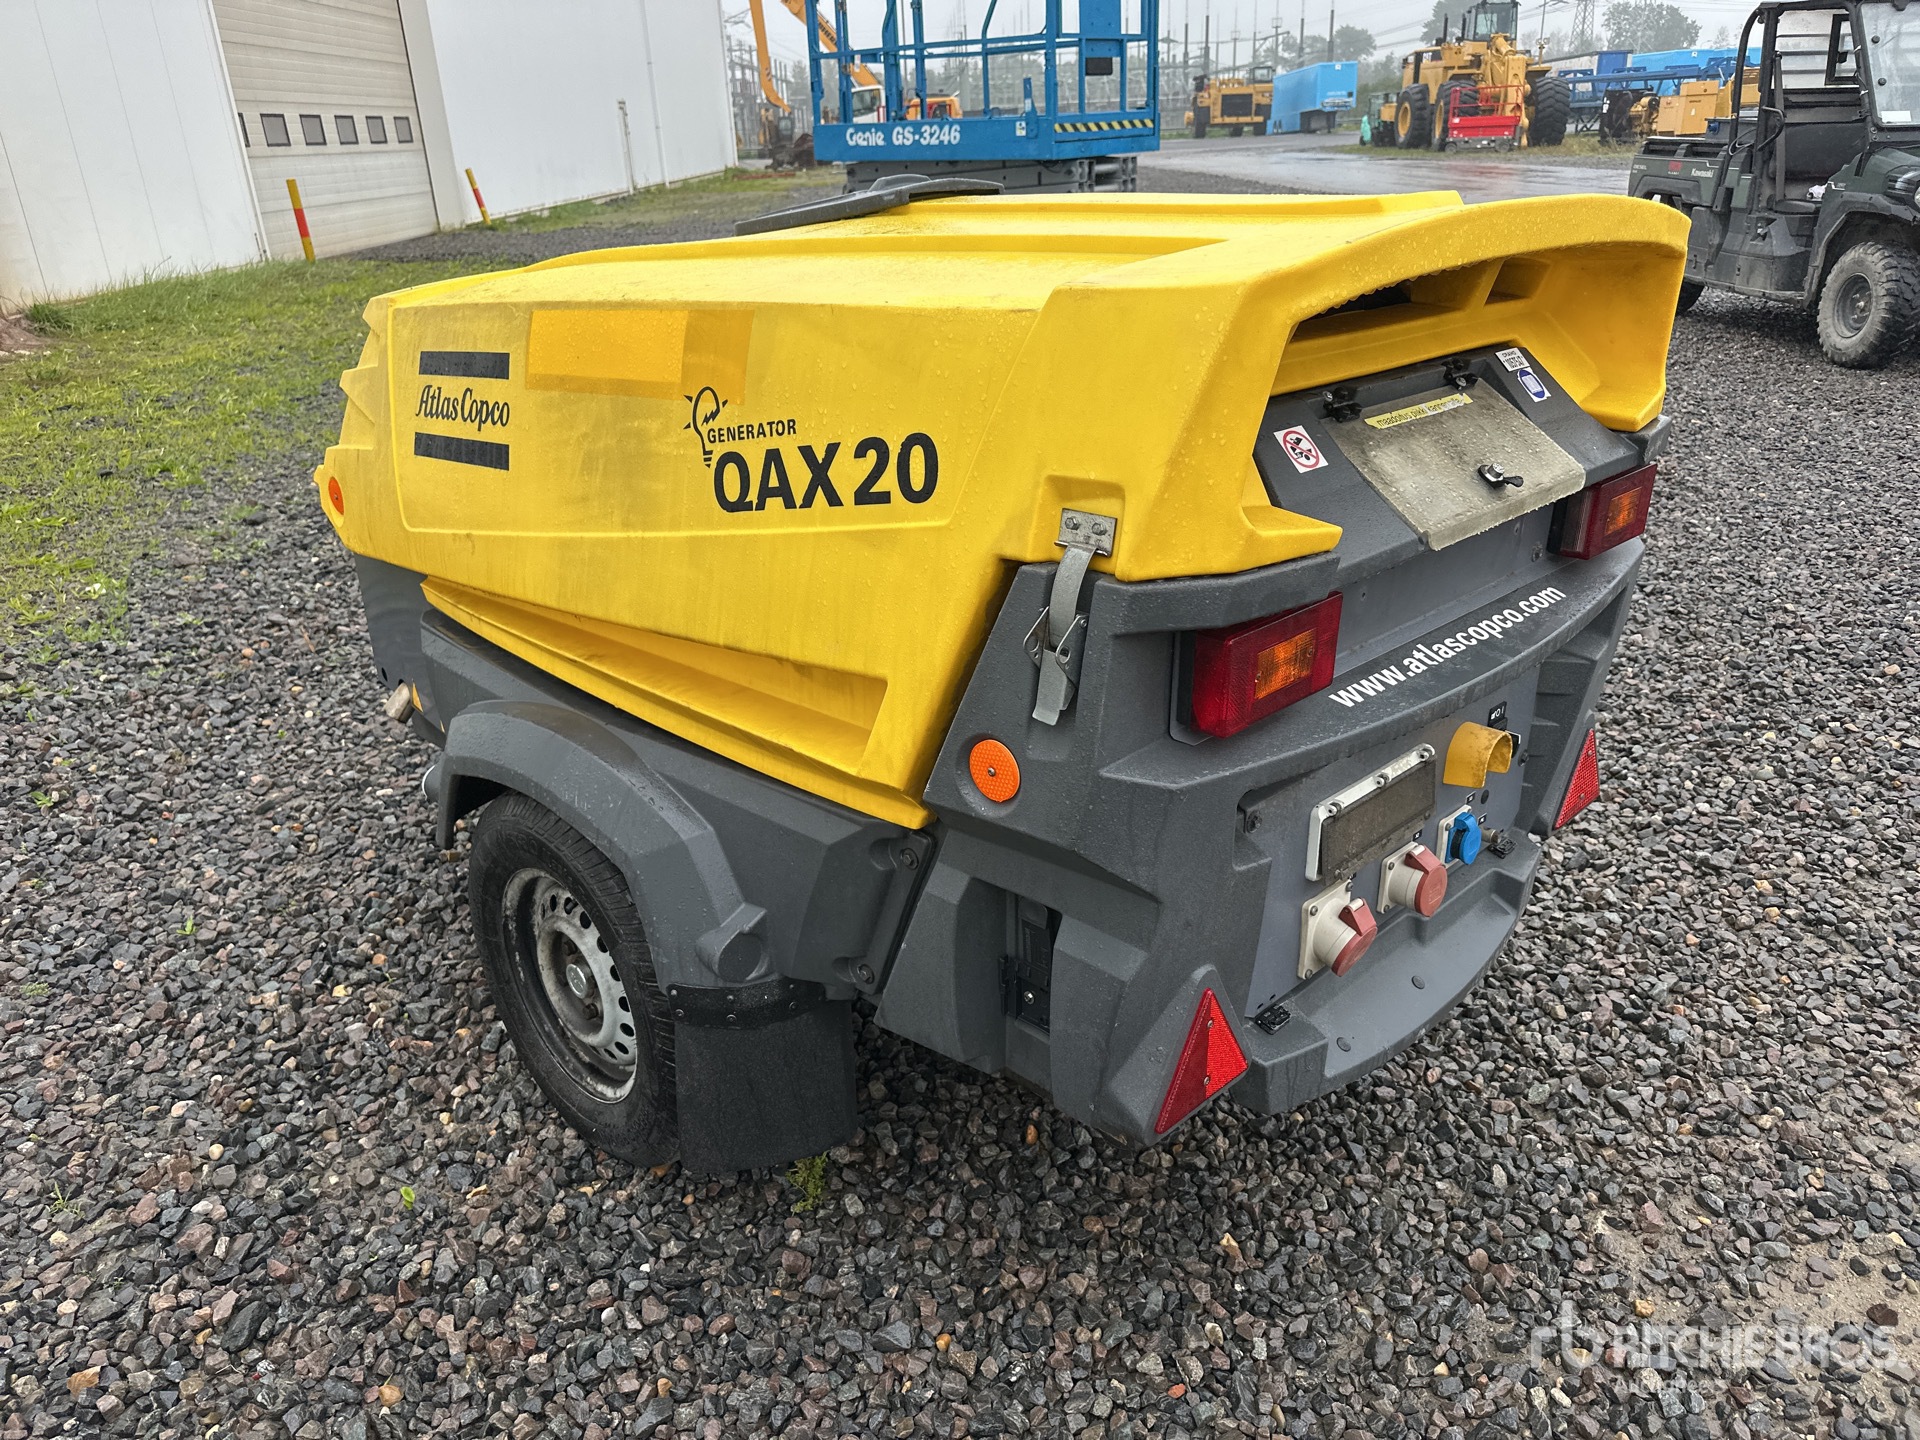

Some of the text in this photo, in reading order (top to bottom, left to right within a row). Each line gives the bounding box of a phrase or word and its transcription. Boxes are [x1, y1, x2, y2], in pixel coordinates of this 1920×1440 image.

[846, 127, 886, 147] Genie
[416, 384, 511, 432] Atlas Copco
[707, 418, 797, 444] GENERATOR
[1328, 585, 1567, 709] www.atlascopco.com
